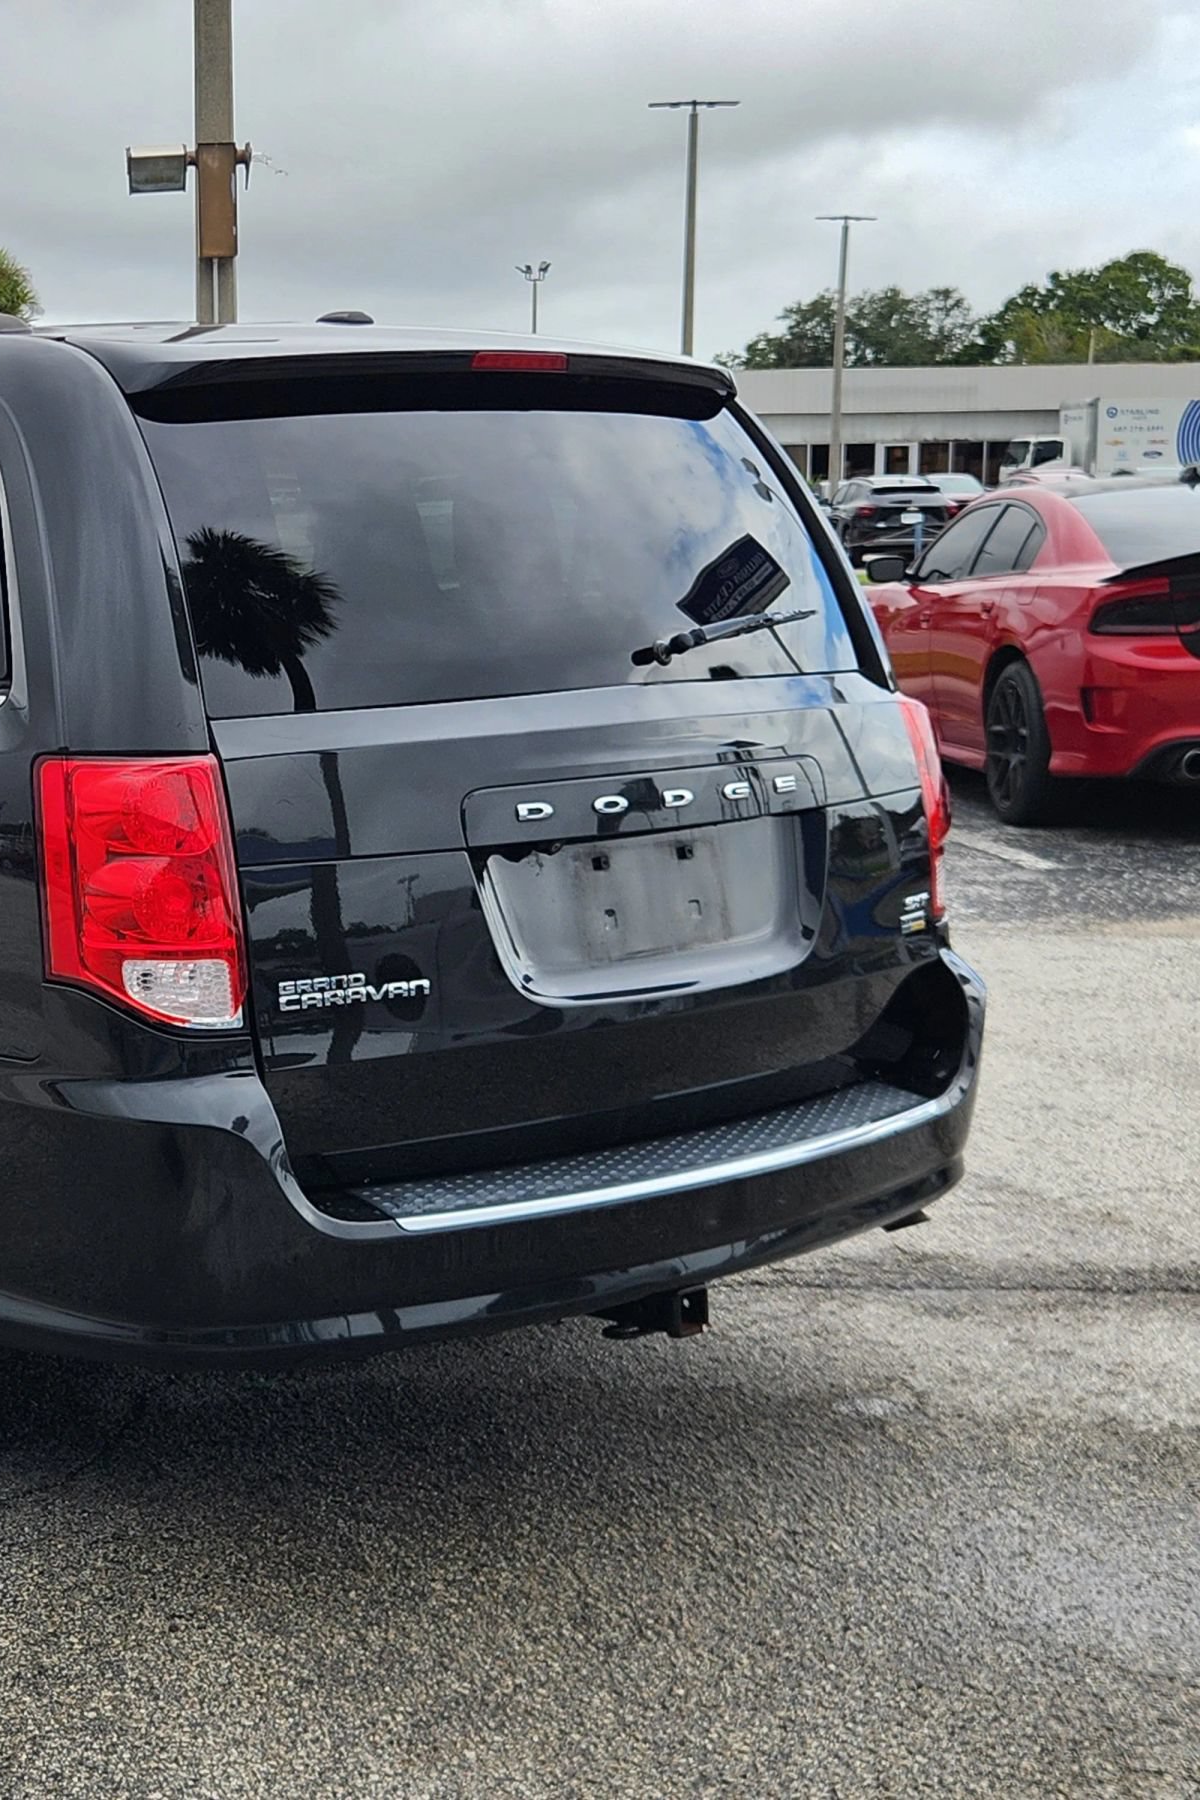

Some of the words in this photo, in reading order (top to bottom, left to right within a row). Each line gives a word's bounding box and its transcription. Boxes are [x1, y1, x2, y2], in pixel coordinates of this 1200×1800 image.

[515, 774, 796, 821] DODGE
[278, 972, 366, 995] GRAND
[278, 979, 431, 1012] CARAVAN
